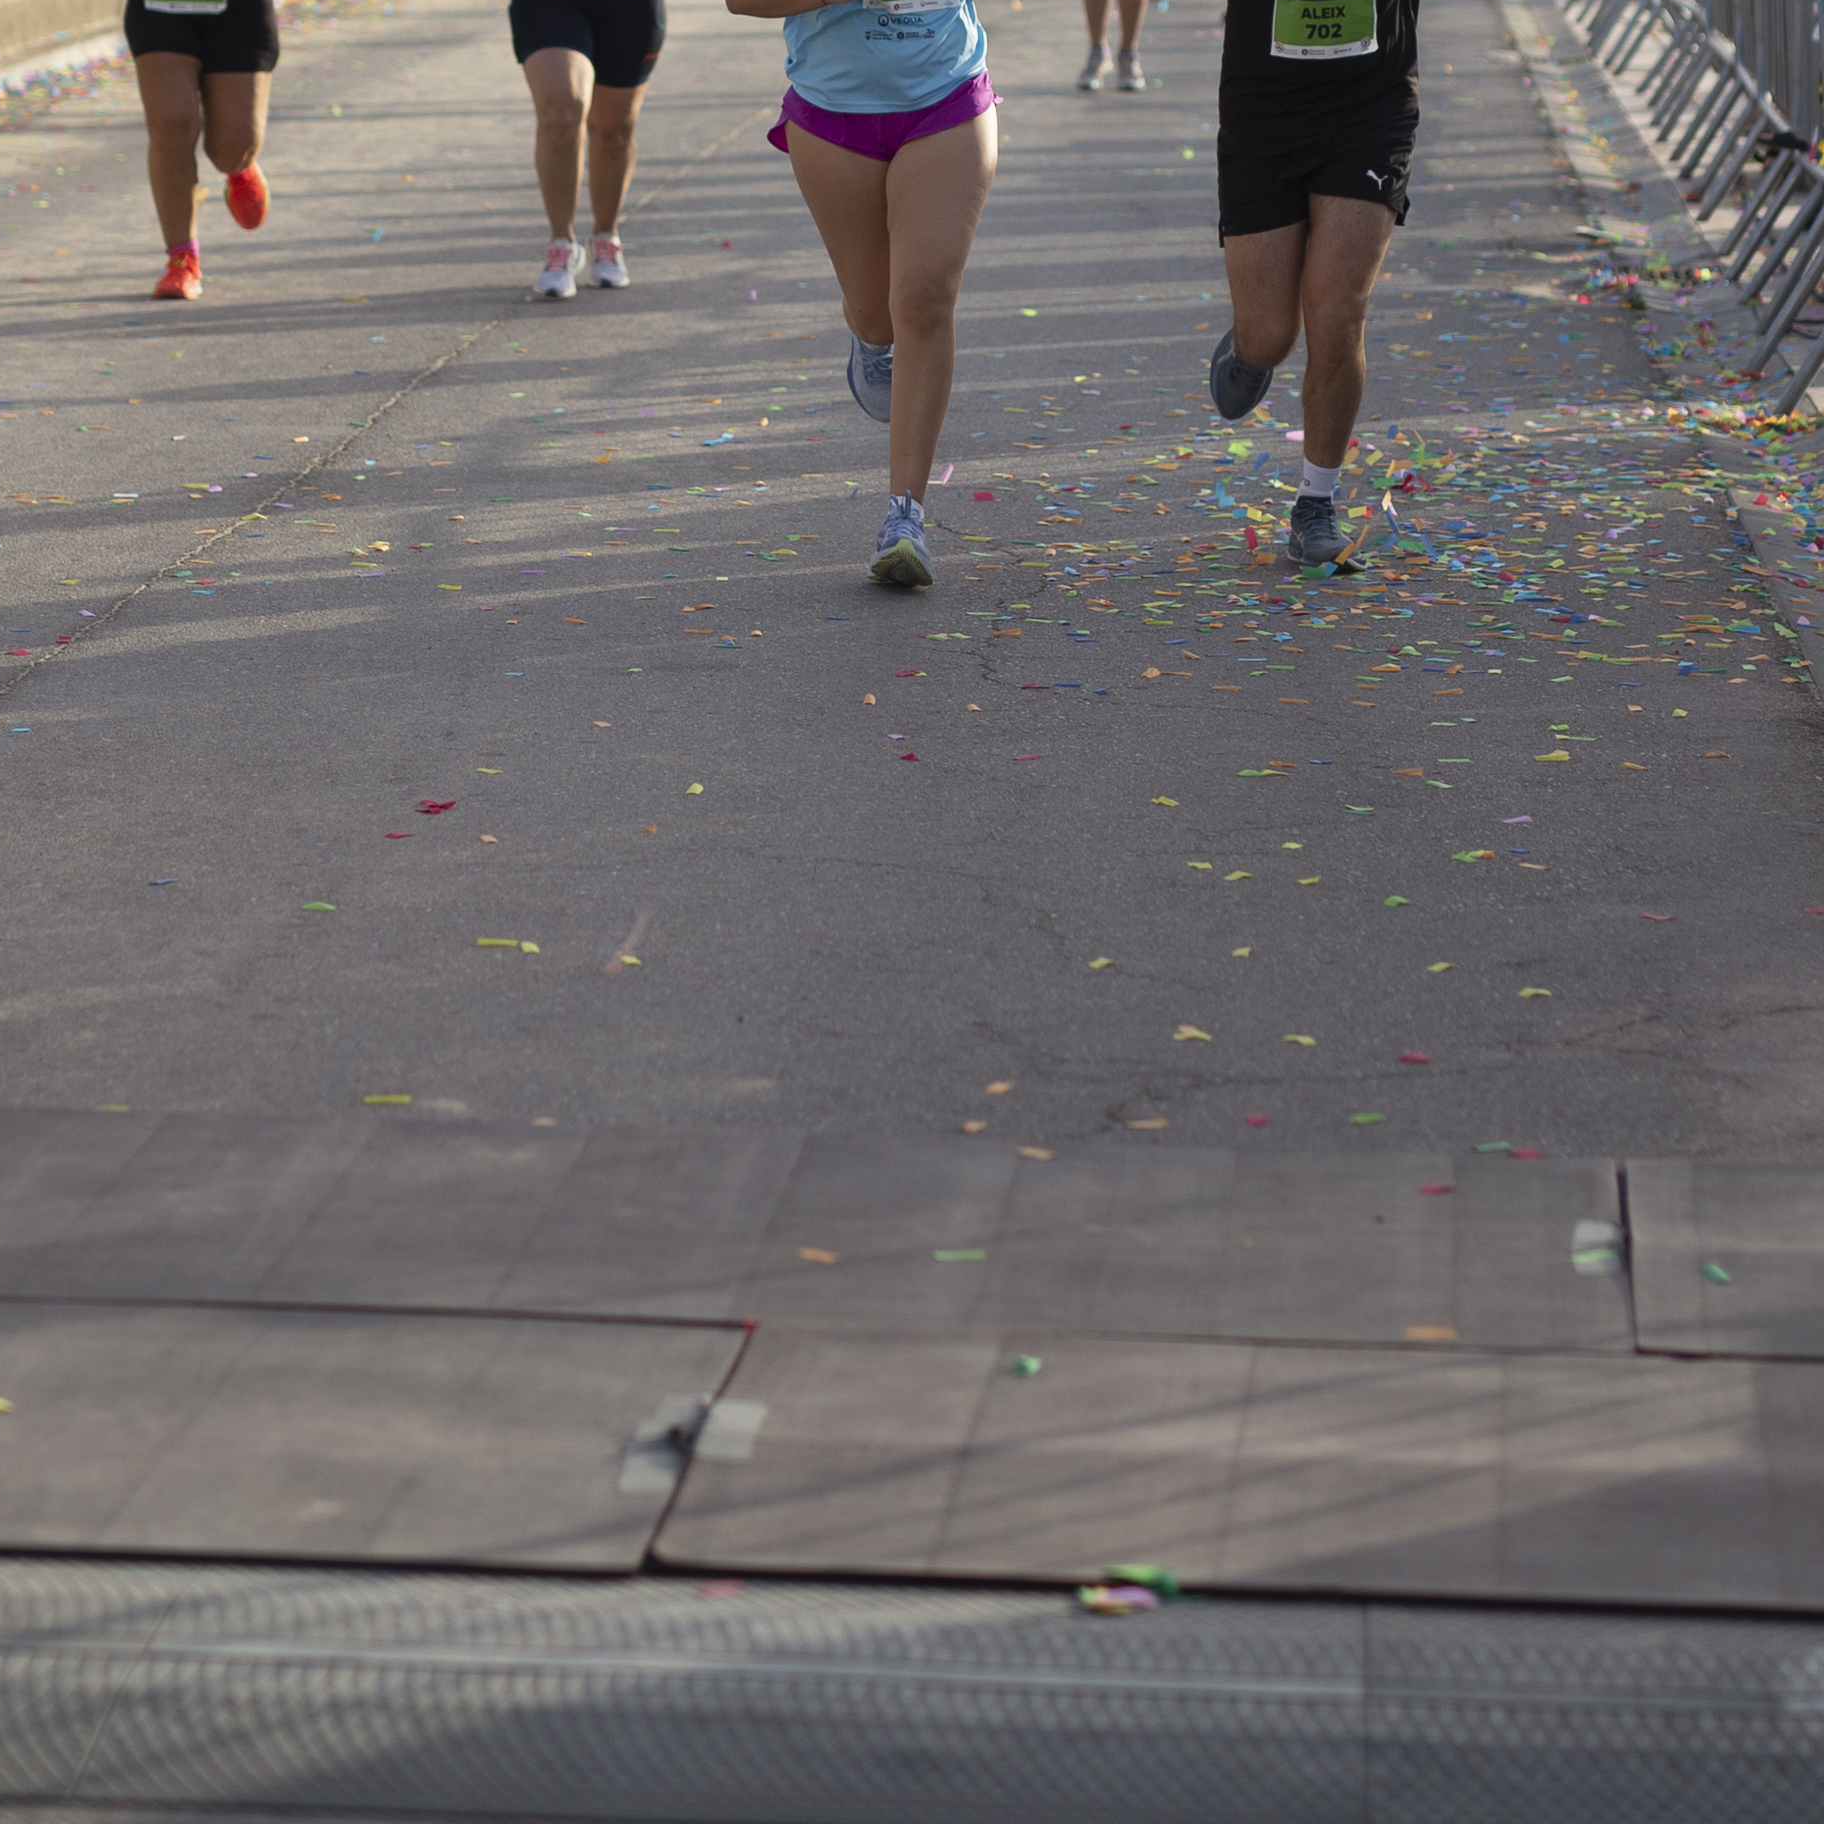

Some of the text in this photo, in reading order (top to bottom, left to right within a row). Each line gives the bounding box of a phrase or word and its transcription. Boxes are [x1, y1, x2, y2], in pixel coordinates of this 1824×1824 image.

[890, 16, 924, 24] VEOLIA
[1301, 5, 1346, 20] ALEIX
[1305, 23, 1343, 40] 702
